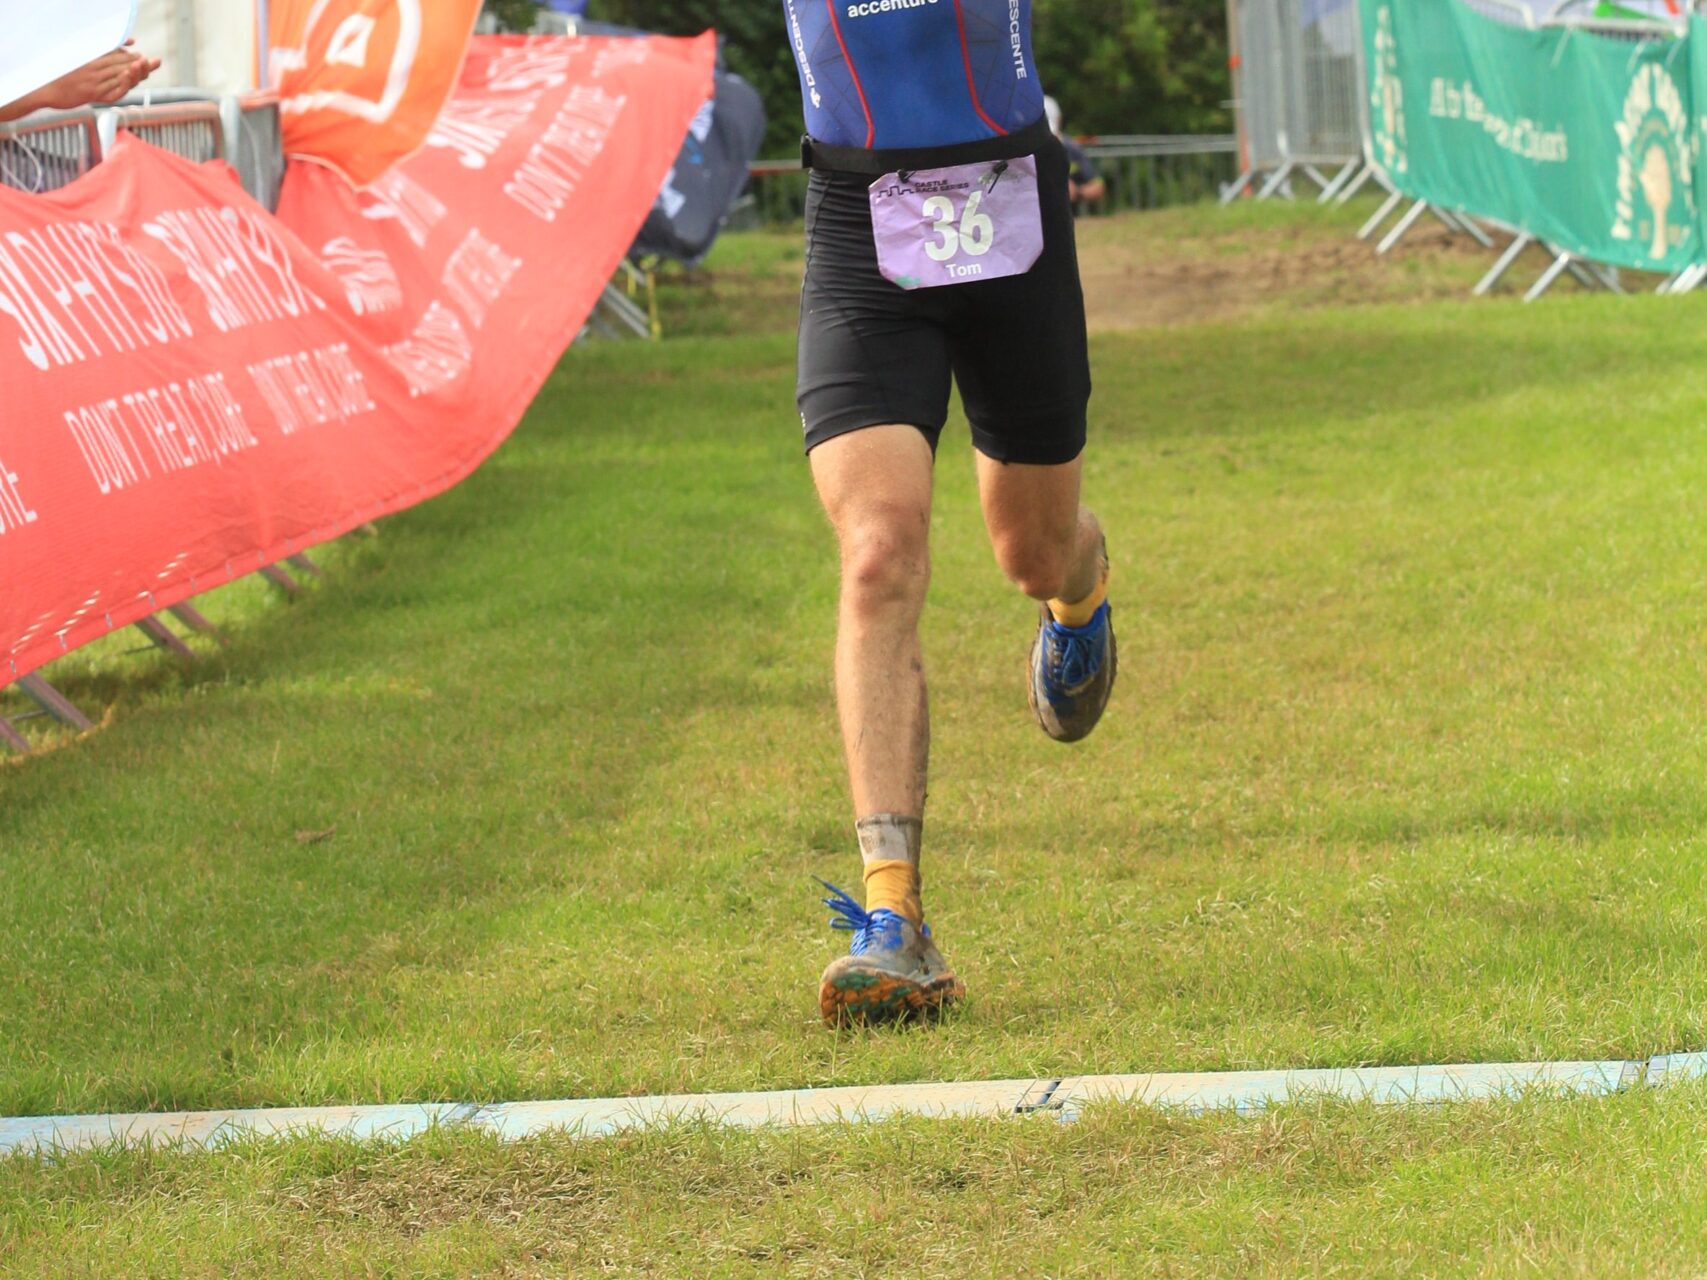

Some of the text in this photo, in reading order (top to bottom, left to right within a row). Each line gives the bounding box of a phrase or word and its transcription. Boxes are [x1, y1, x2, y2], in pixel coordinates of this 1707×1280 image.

[915, 180, 948, 188] CASTLE
[916, 182, 969, 193] RACE SERIES
[922, 190, 994, 261] 36
[945, 263, 982, 278] Tom
